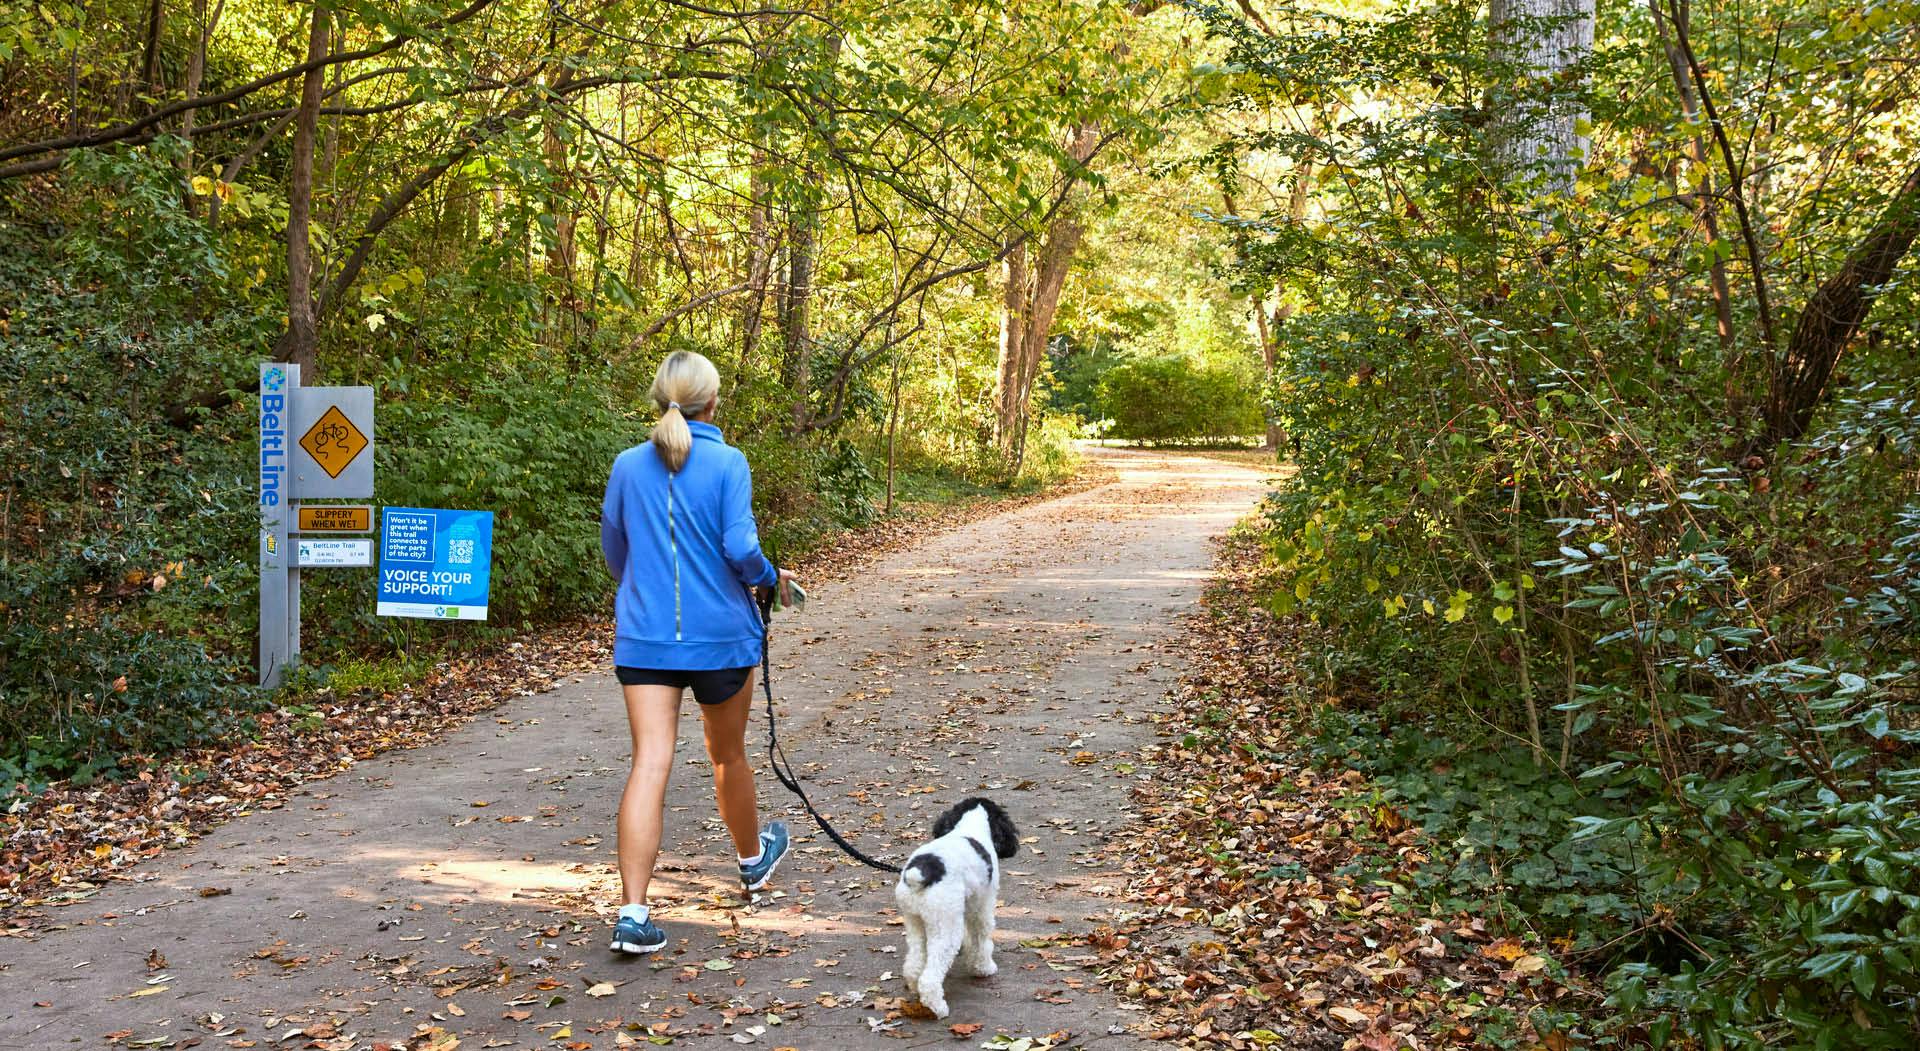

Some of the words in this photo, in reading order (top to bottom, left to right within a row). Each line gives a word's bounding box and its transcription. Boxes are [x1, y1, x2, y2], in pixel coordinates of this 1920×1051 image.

[261, 394, 285, 507] BeltLine
[311, 520, 336, 528] WHEN
[338, 520, 357, 528] WET
[410, 551, 426, 559] city?
[384, 570, 428, 582] VOICE
[432, 572, 472, 584] YOUR
[384, 583, 453, 595] SUPPORT!
